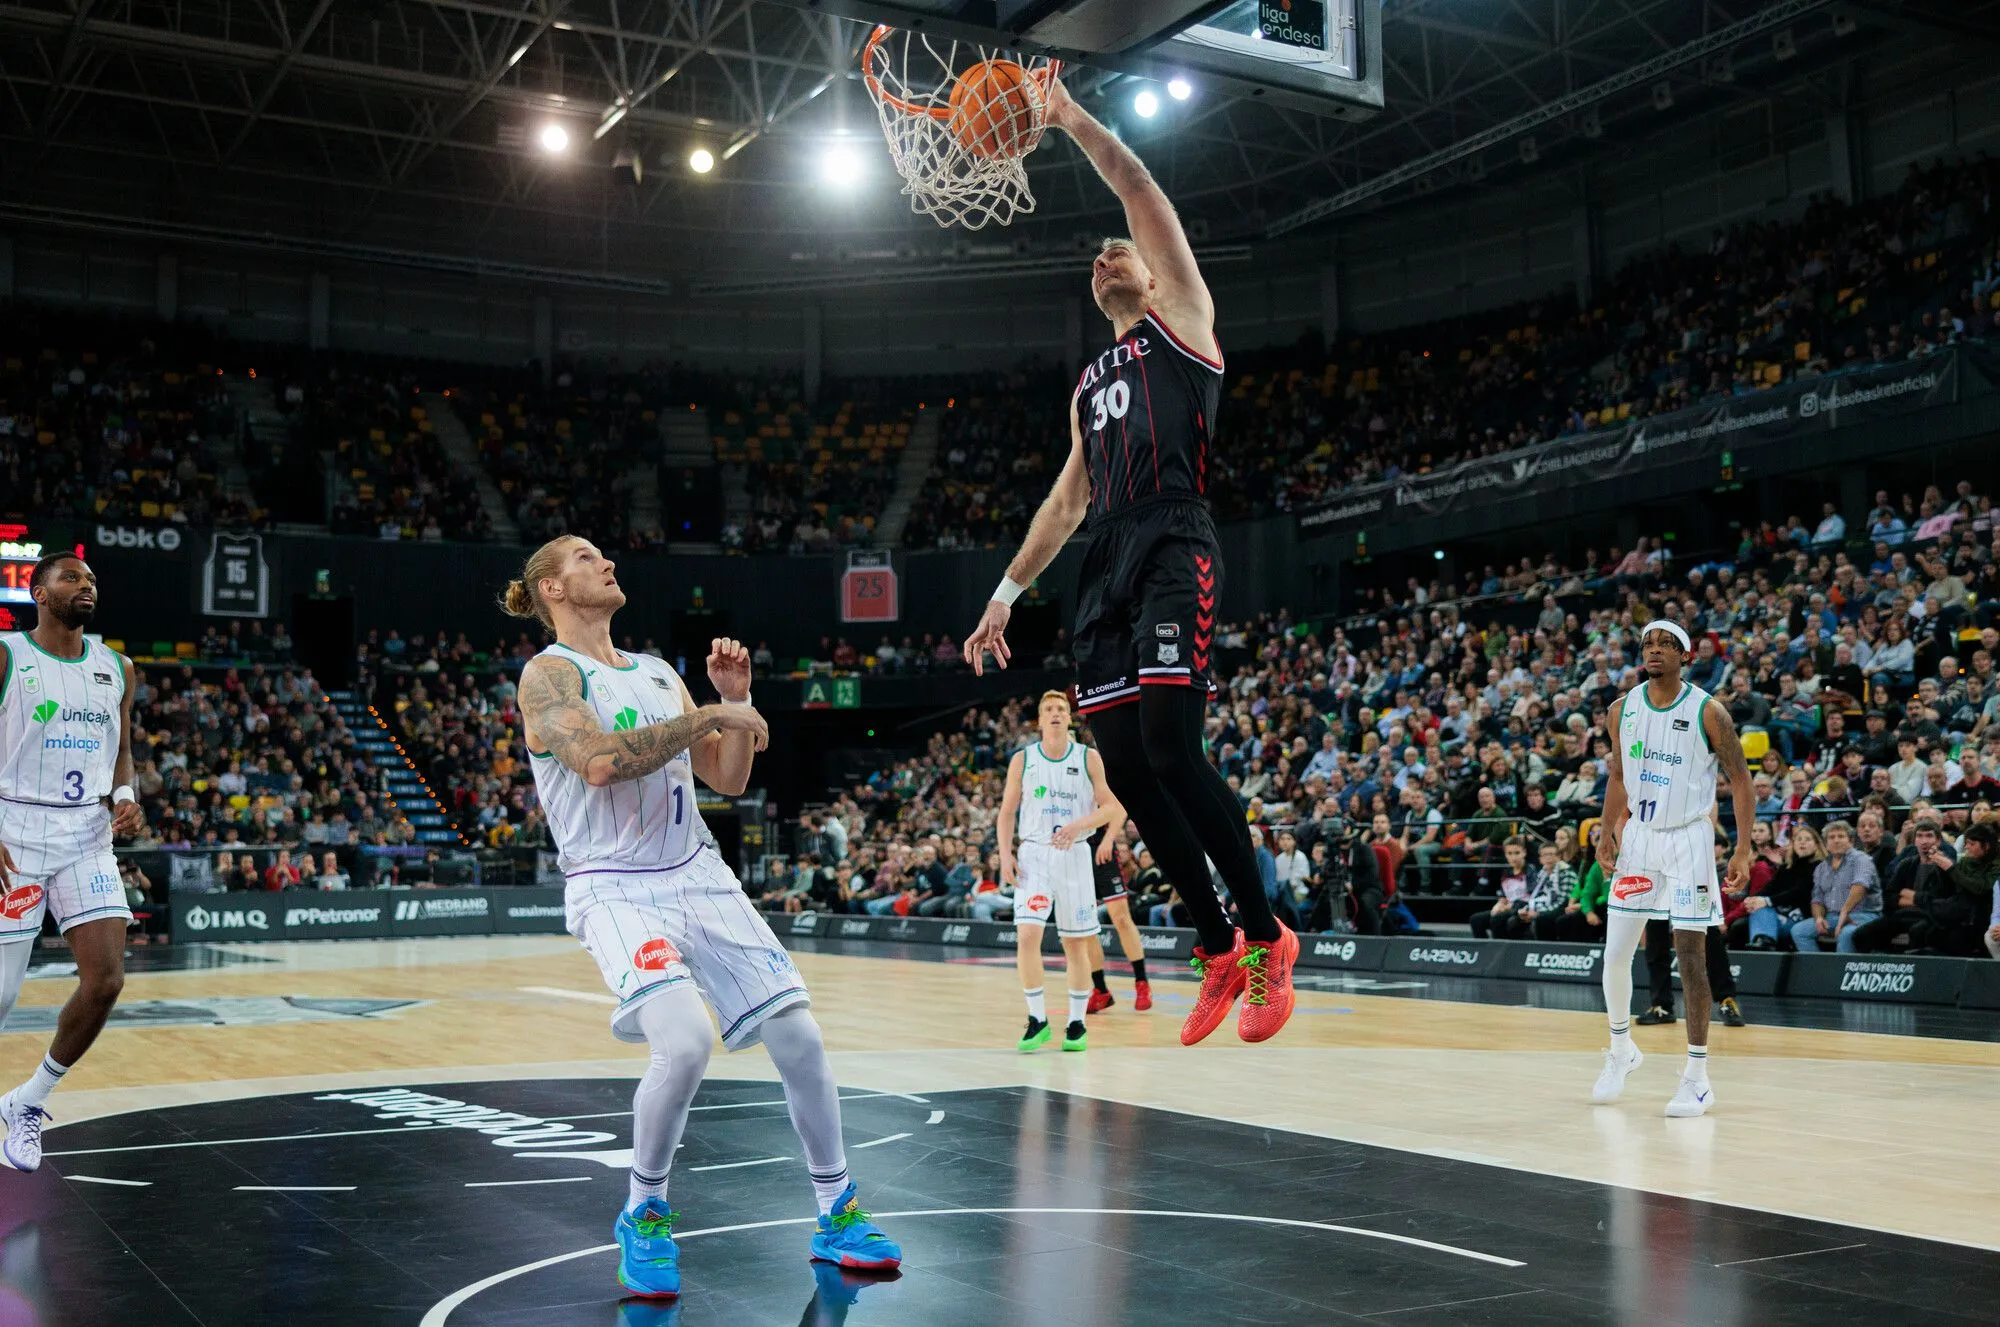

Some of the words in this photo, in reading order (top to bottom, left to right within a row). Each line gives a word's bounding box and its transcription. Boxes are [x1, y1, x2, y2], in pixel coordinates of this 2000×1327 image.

[1261, 4, 1289, 23] liga
[1262, 22, 1322, 47] endesa
[1091, 380, 1130, 431] 30
[97, 525, 155, 548] bbk
[225, 559, 248, 584] 15
[857, 577, 883, 598] 25
[808, 684, 826, 701] A
[1095, 680, 1125, 693] CORREO
[62, 708, 110, 726] Unicaja
[1643, 748, 1682, 766] Unicaja
[63, 770, 85, 801] 3
[672, 784, 683, 825] 1
[1639, 799, 1657, 822] 11
[425, 897, 488, 911] MEDRANO
[211, 909, 269, 930] IMQ
[308, 907, 381, 924] Petronor
[1314, 942, 1341, 956] bbk
[1524, 953, 1540, 967] EL
[1541, 953, 1594, 970] CORREO
[1840, 971, 1915, 993] LANDAKO
